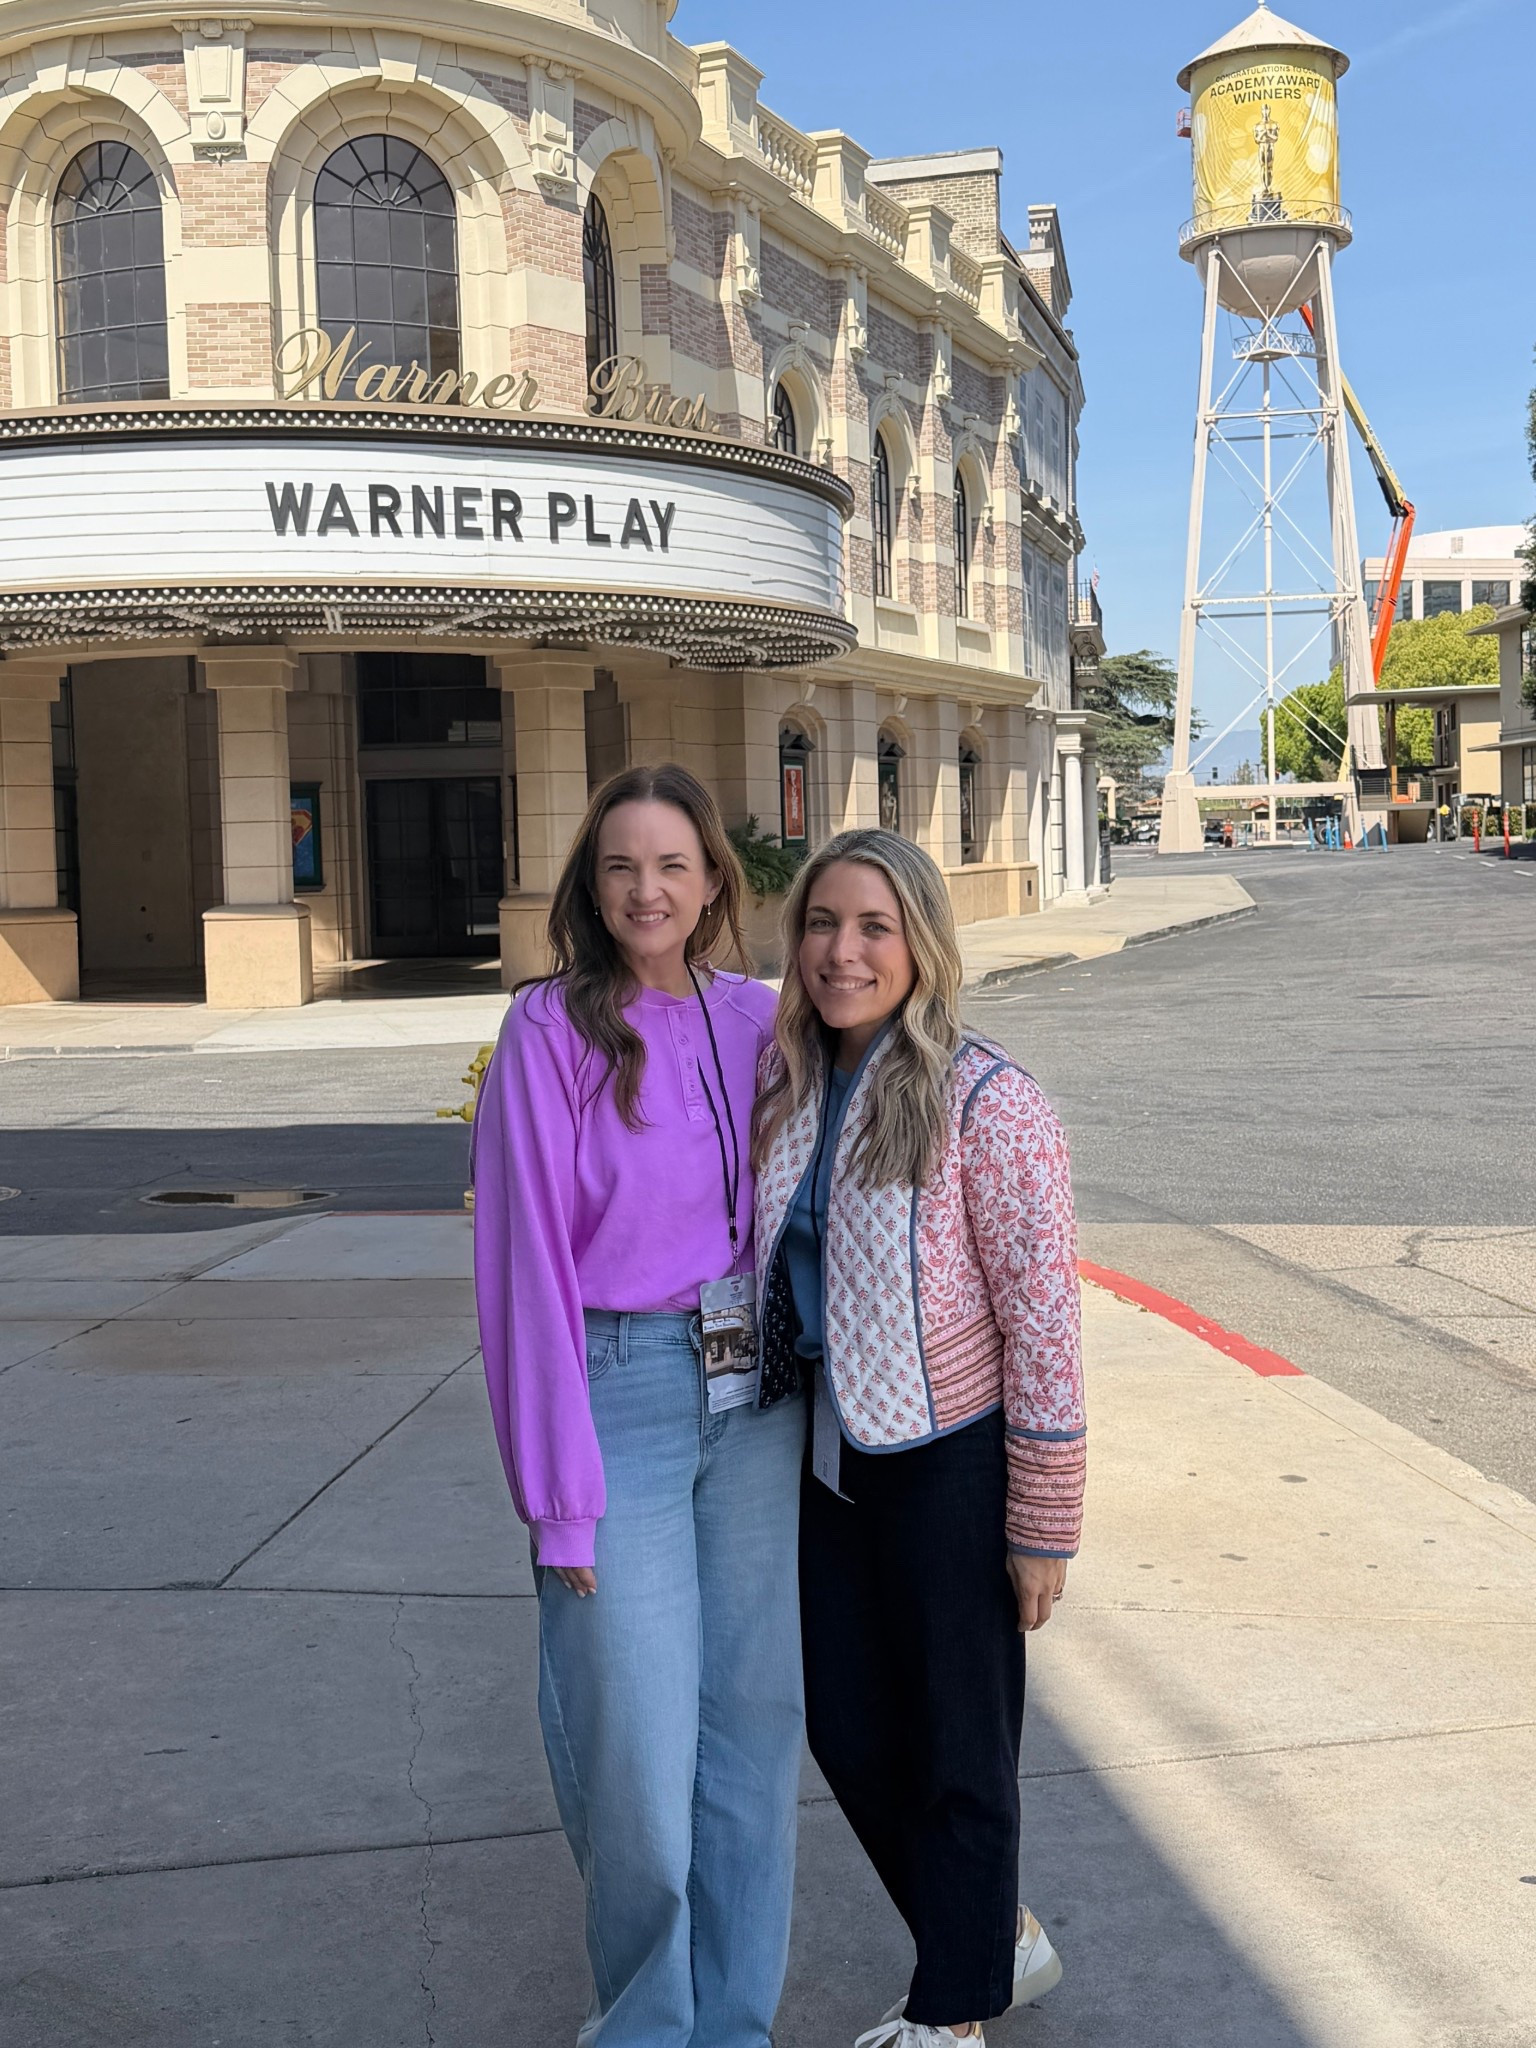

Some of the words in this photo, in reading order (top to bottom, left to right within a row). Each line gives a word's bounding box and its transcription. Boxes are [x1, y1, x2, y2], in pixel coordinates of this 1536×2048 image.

[1216, 65, 1290, 82] CONGRATULATIONS
[1210, 75, 1275, 98] ACADEMY
[1277, 75, 1320, 89] AWARD
[1233, 88, 1302, 105] WINNERS
[275, 325, 540, 413] Warner
[265, 481, 524, 541] WARNER
[547, 491, 676, 552] PLAY
